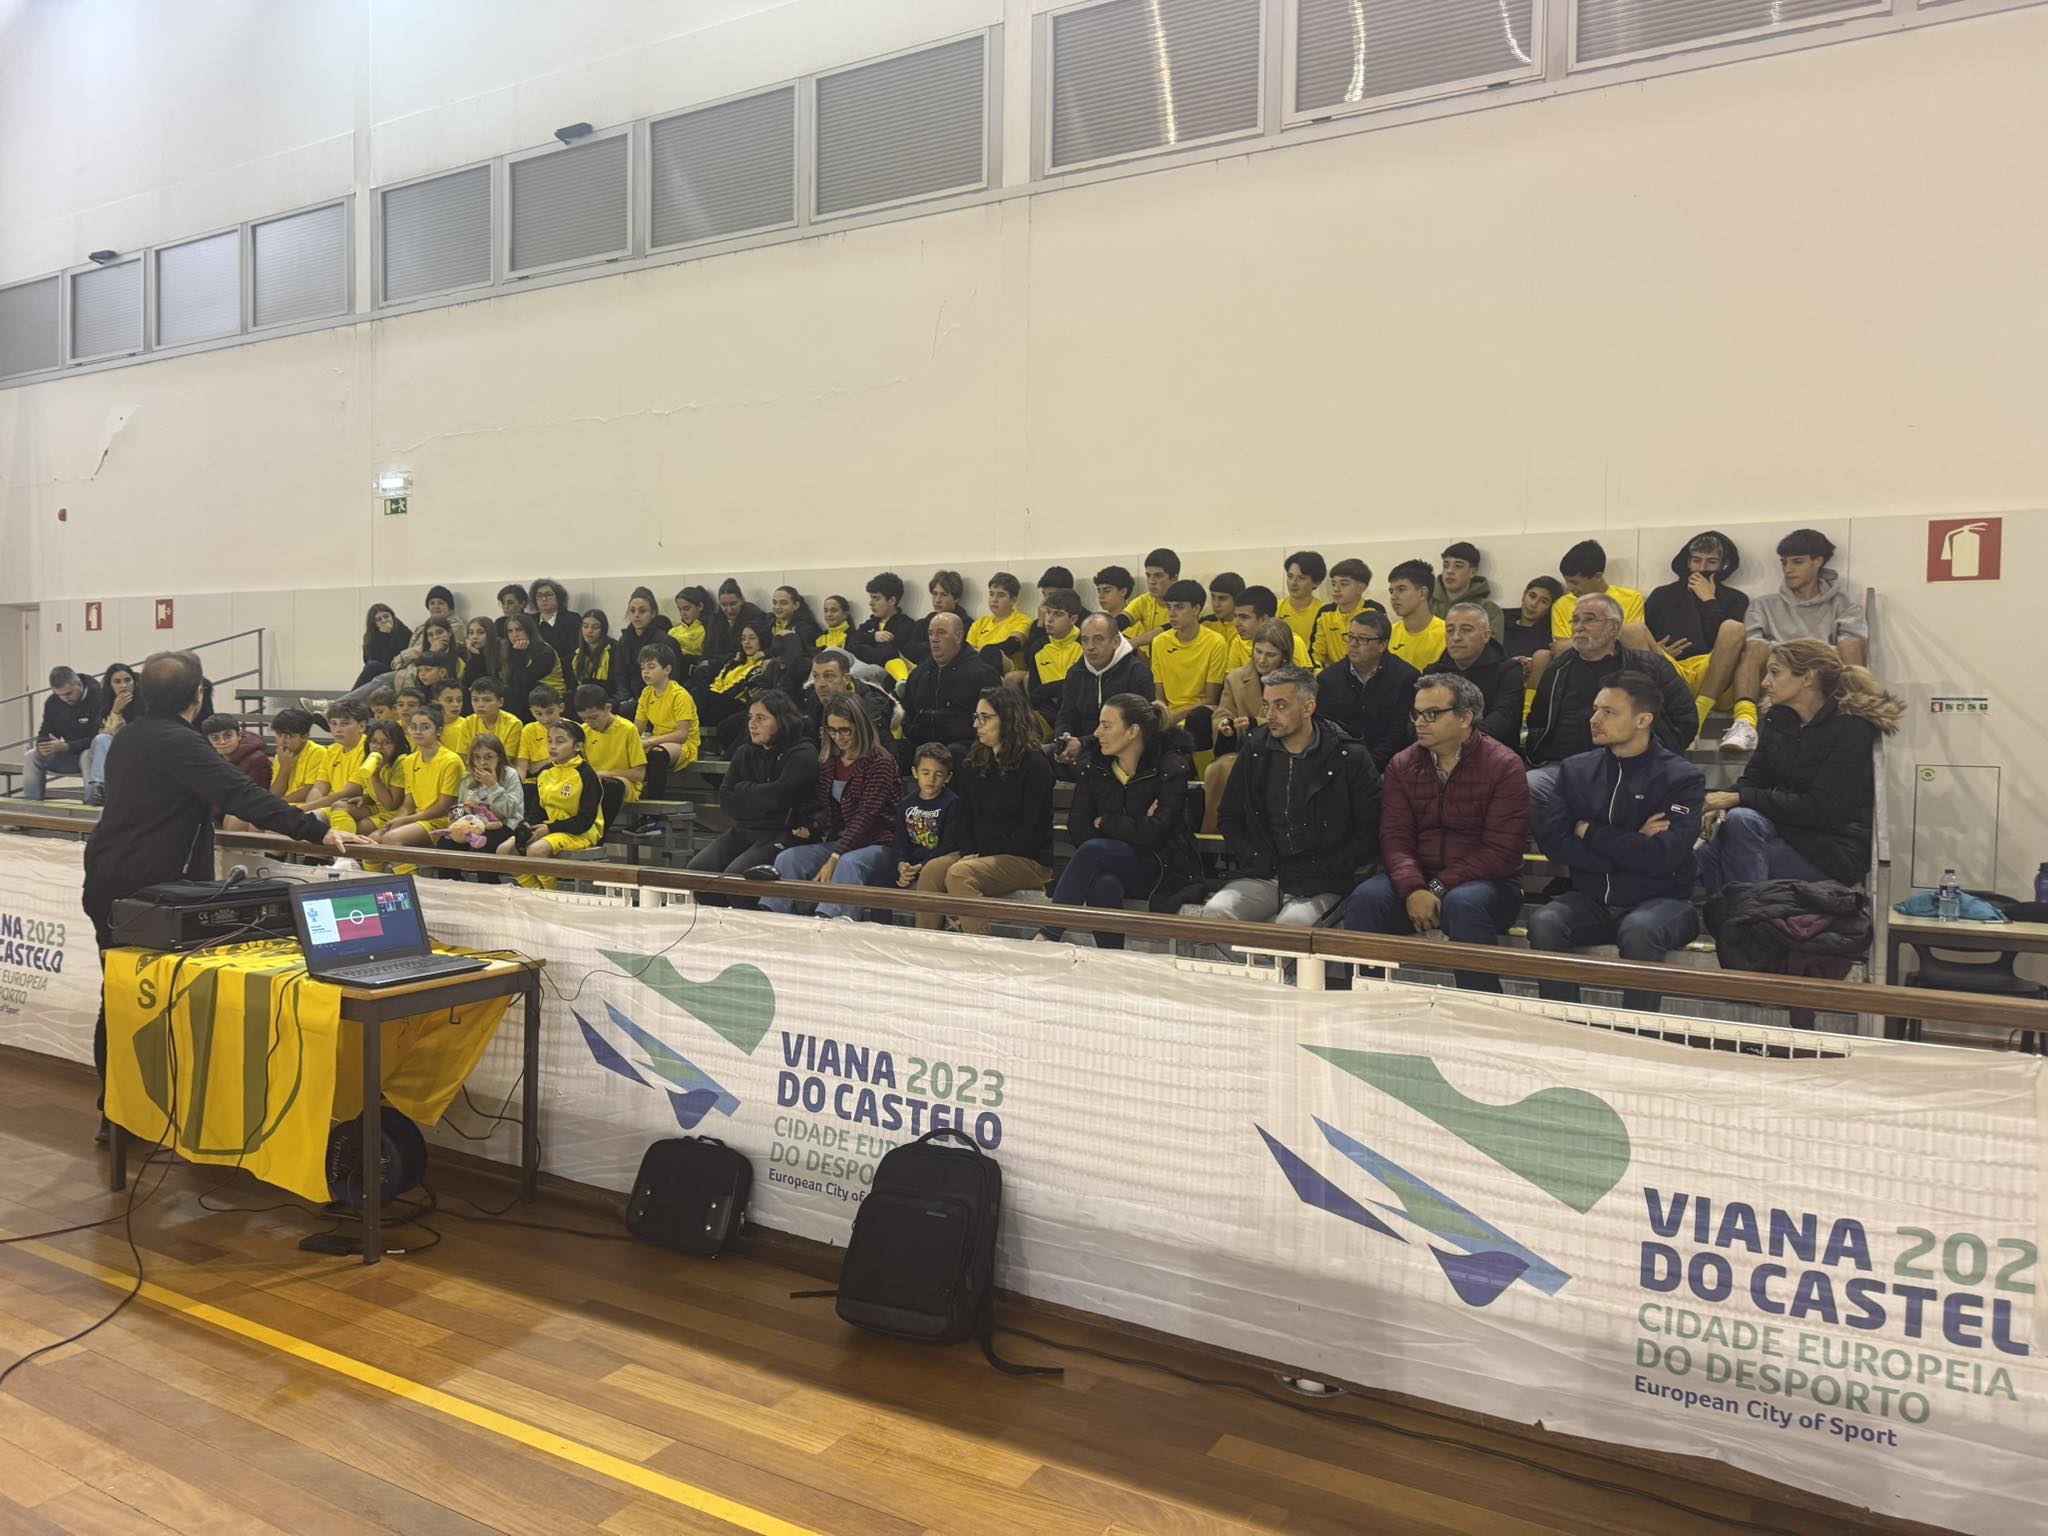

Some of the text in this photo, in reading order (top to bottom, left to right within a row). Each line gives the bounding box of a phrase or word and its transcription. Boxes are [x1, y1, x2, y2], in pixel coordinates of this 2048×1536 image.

[26, 919, 66, 947] 2023
[2, 969, 48, 991] EUROPEIA
[781, 1031, 1005, 1107] VIANA 2023
[774, 1116, 850, 1151] CIDADE
[777, 1071, 1002, 1150] DO CASTELO
[768, 1167, 822, 1193] European
[826, 1182, 849, 1202] City
[769, 1141, 875, 1185] DO DESPO
[1643, 1187, 1872, 1271] VIANA
[1640, 1241, 1733, 1302] DO
[1636, 1337, 1930, 1424] DO DESPORTO
[1637, 1302, 2018, 1401] CIDADE EUROPEIA
[1634, 1375, 1898, 1447] European City of Sport
